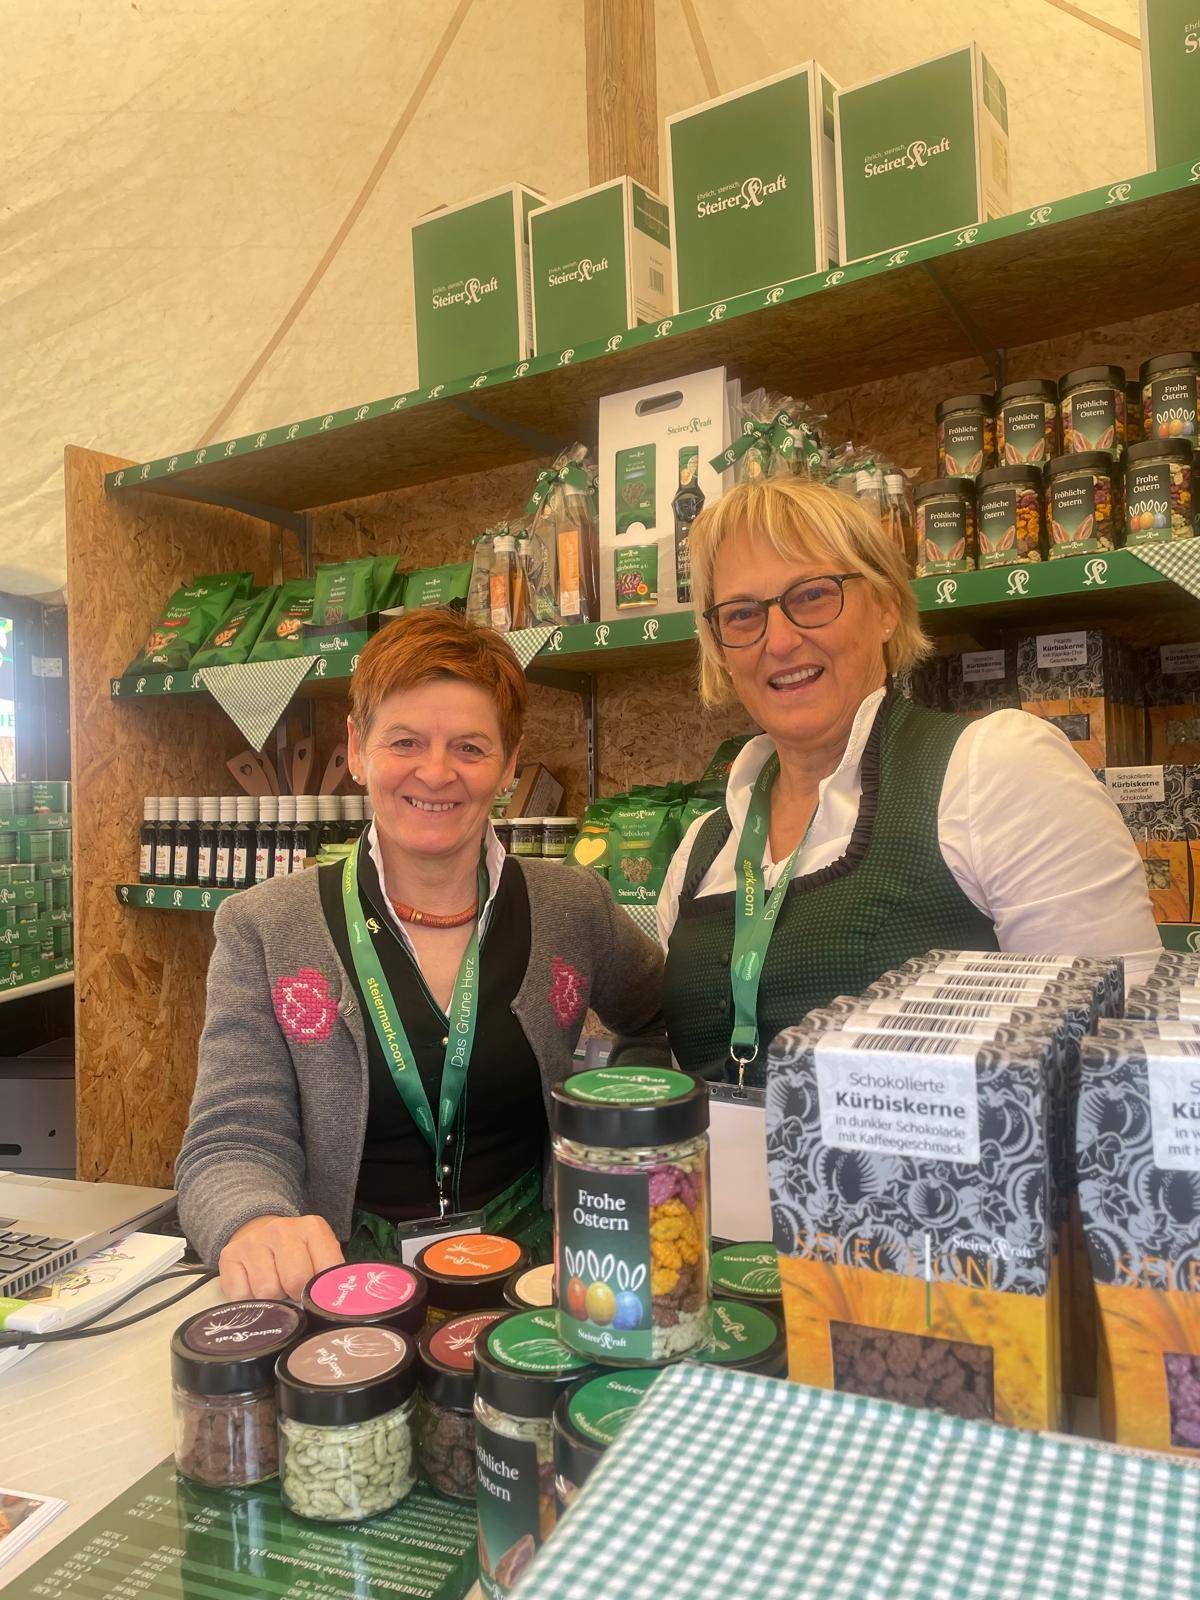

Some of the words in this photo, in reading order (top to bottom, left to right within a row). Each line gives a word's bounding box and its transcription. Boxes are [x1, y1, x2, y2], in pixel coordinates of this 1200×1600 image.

[864, 136, 951, 178] SteirerKraft
[697, 188, 716, 201] Ehrlich,
[697, 174, 787, 219] SteirerKraft
[548, 258, 609, 288] SteirerKraft
[432, 277, 498, 309] SteirerKraft
[1164, 384, 1188, 392] Frohe
[1162, 391, 1188, 401] Ostern
[1076, 399, 1108, 411] Fröhliche
[1008, 412, 1040, 424] Fröhliche
[1080, 408, 1104, 417] Ostern
[948, 426, 978, 434] Fröhliche
[1012, 422, 1036, 431] Ostern
[952, 434, 974, 442] Ostern
[1136, 474, 1158, 484] Frohe
[1054, 488, 1086, 500] Fröhliche
[1133, 482, 1160, 493] Ostern
[1058, 498, 1082, 508] Ostern
[930, 510, 960, 520] Fröhliche
[984, 509, 1004, 519] Ostern
[934, 520, 957, 528] Ostern
[1042, 643, 1084, 652] Kürbiskerne
[1112, 780, 1160, 788] Kürbiskerne
[619, 810, 656, 819] SteirerKraft
[619, 886, 656, 900] SteirerKraft
[764, 892, 781, 920] Das
[463, 957, 474, 988] Herz
[459, 992, 472, 1034] Grüne
[367, 977, 406, 1072] steiermark.com
[451, 1039, 467, 1067] Das
[849, 1072, 945, 1094] Schokolierte
[836, 1091, 967, 1120] Kürbiskerne
[836, 1116, 846, 1128] in
[848, 1116, 893, 1132] dunkler
[896, 1119, 966, 1140] Schokolade
[838, 1131, 857, 1143] mit
[860, 1133, 964, 1156] Kaffeegeschmack
[1168, 1143, 1190, 1155] mit
[577, 1189, 626, 1212] Frohe
[573, 1211, 629, 1232] Ostern
[953, 1235, 1033, 1260] SteirerKraft
[796, 1230, 994, 1287] SELECTION
[577, 1329, 627, 1349] SteirerKraft
[358, 1527, 400, 1540] Steirische
[399, 1536, 465, 1555] STEIRERKRAFT
[266, 1553, 321, 1570] Käferbohnen
[322, 1567, 366, 1581] Steirische
[366, 1578, 433, 1598] STEIRERKRAFT
